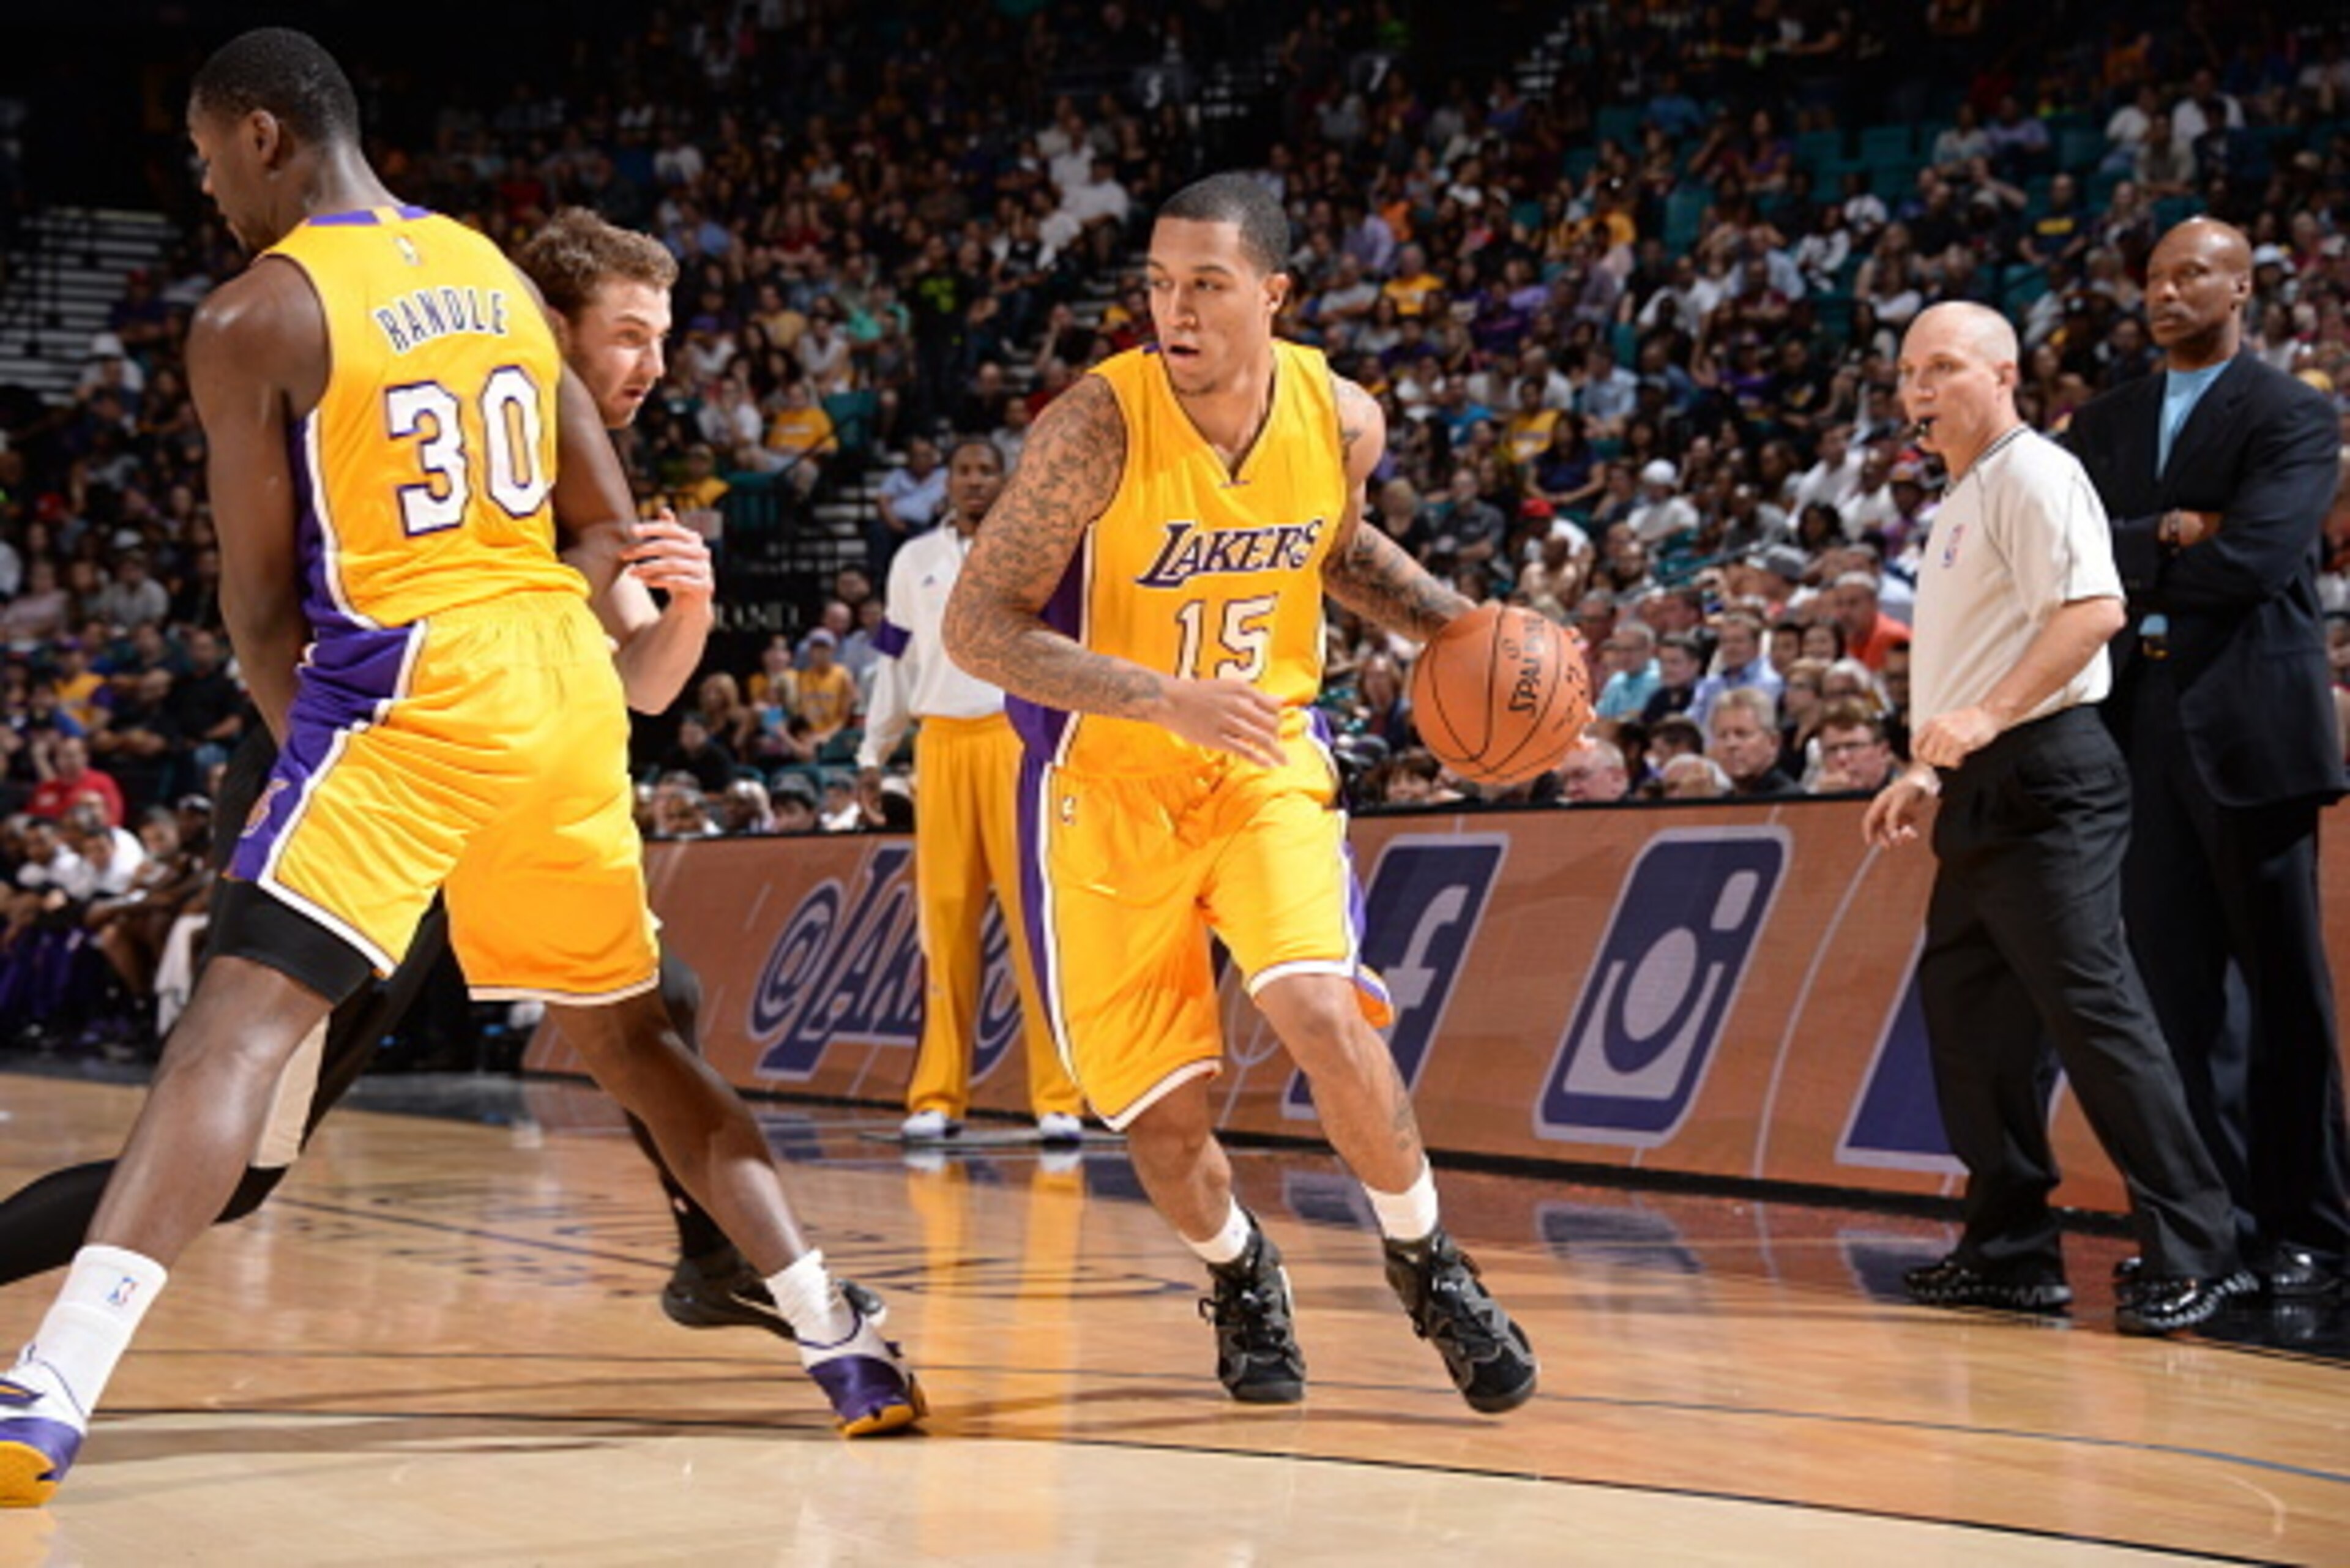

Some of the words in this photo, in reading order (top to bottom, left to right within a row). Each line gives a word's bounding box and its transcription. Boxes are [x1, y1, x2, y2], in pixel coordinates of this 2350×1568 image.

[375, 285, 507, 352] RANDLE
[385, 365, 555, 537] 30
[1135, 519, 1323, 589] LAKERS
[1174, 592, 1279, 682] 15
